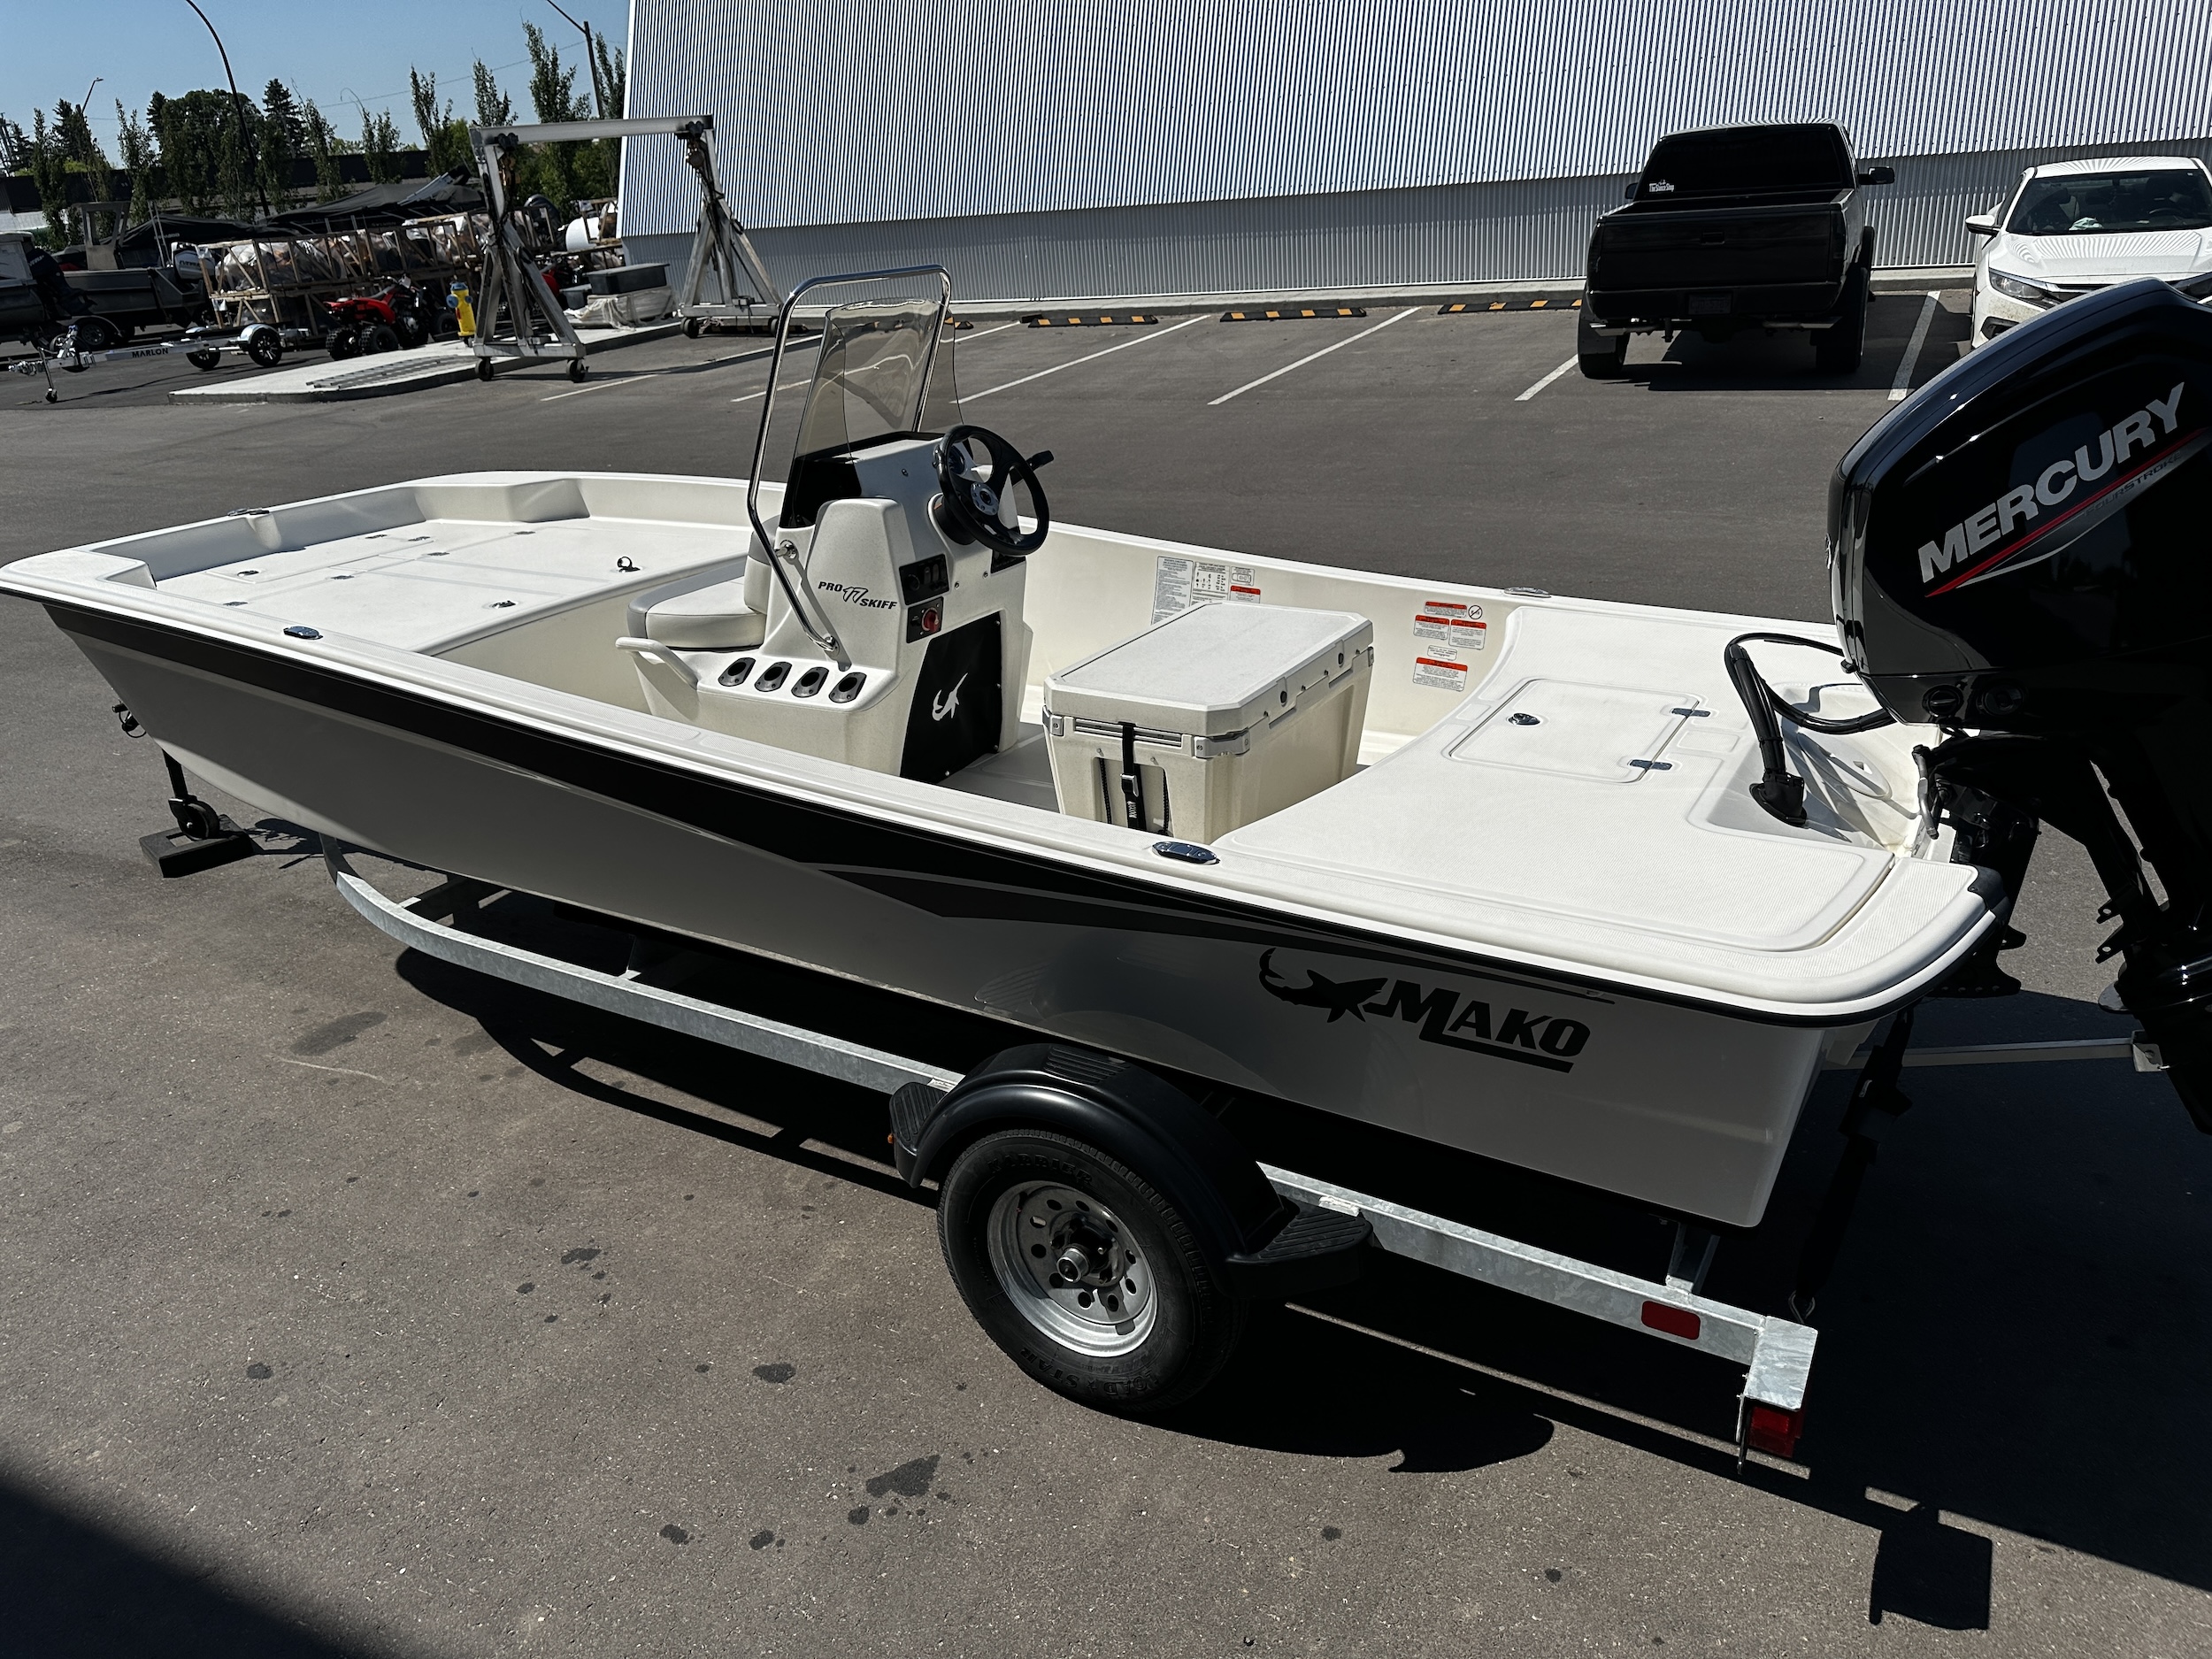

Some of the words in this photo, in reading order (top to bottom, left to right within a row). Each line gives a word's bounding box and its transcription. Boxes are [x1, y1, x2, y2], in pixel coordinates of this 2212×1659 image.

[132, 348, 168, 357] MARLON
[1917, 381, 2185, 583] MERCURY
[2082, 449, 2182, 518] FOURSTROKE
[818, 581, 844, 592] PRO
[842, 587, 869, 603] 17
[859, 598, 898, 610] SKIFF
[1364, 979, 1592, 1073] MAKO
[987, 1153, 1093, 1186] KARRIER
[1018, 1347, 1080, 1388] STAR
